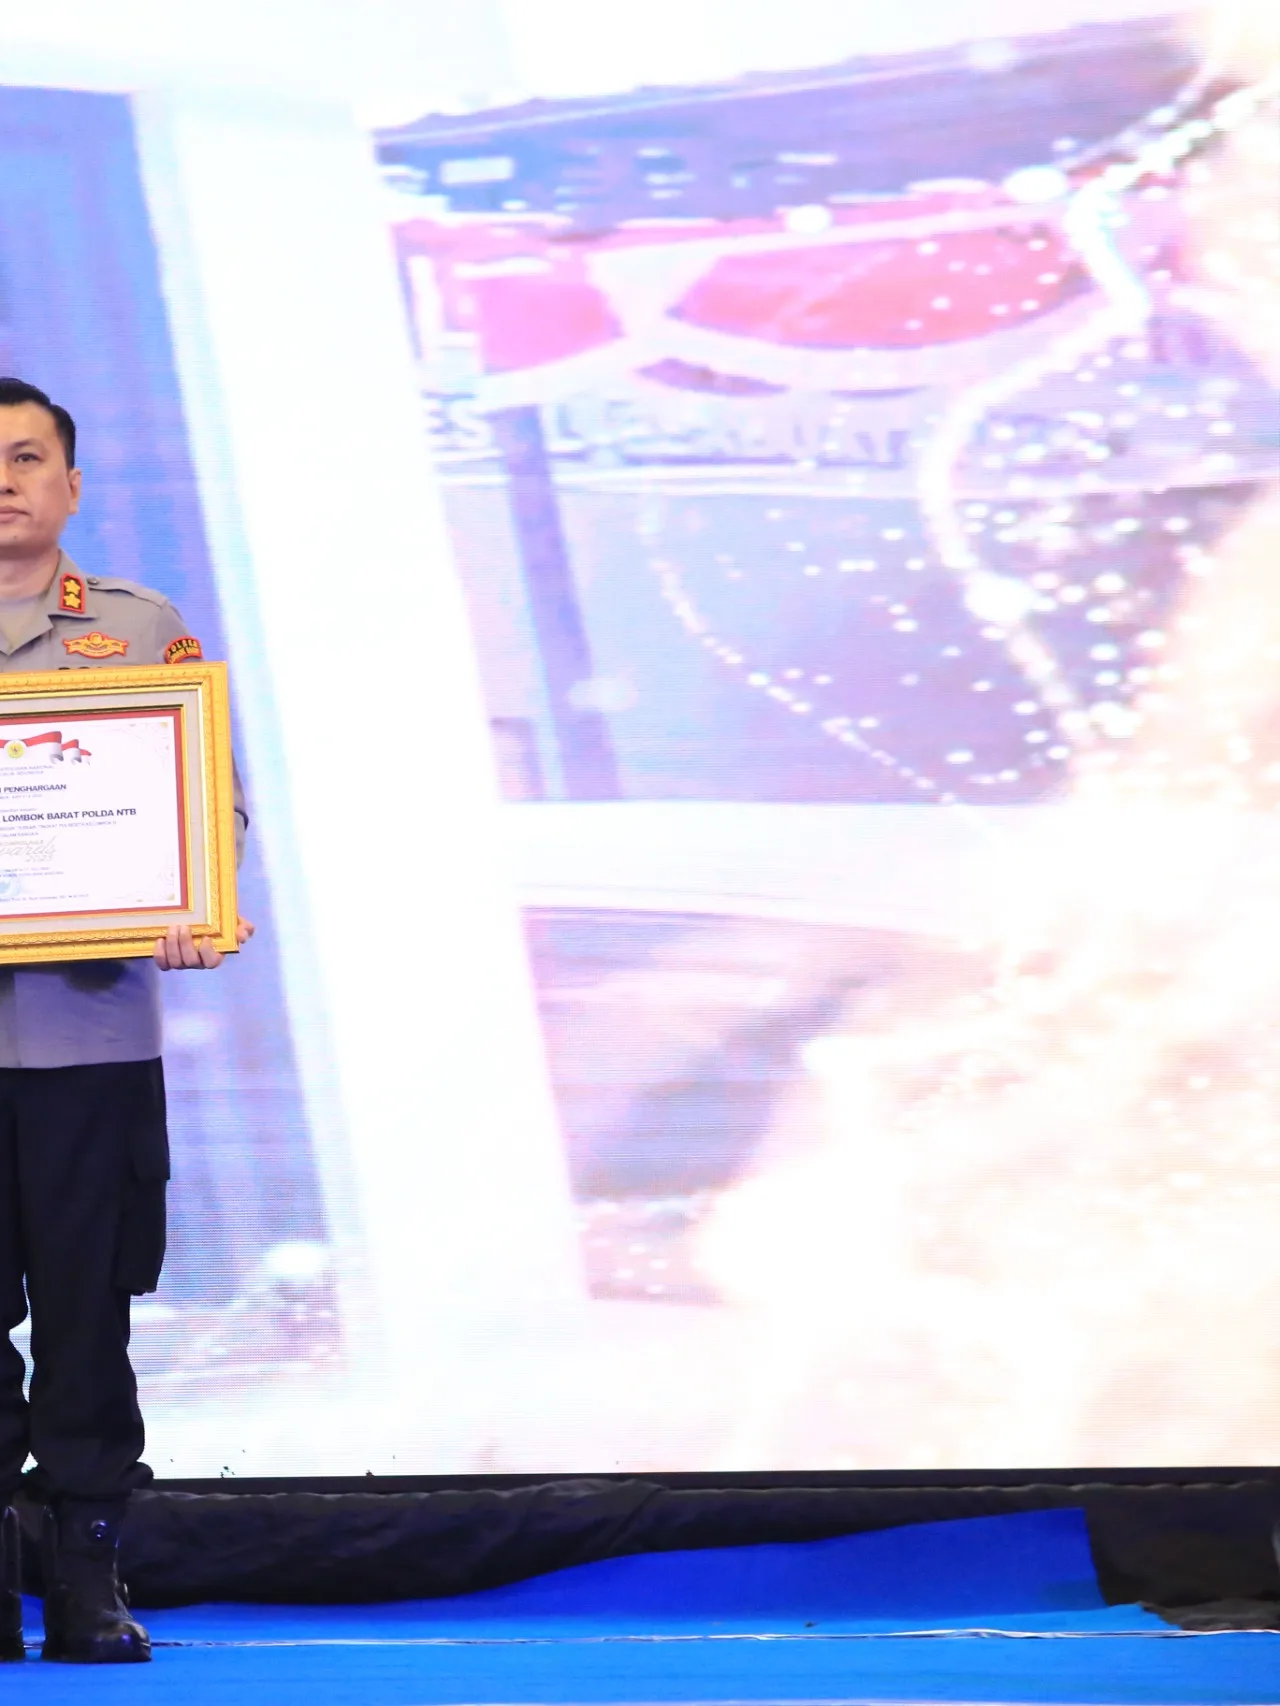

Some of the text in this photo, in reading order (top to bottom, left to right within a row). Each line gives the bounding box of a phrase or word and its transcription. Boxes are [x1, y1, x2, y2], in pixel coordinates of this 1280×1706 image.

[3, 784, 67, 793] PENGHARGAAN
[2, 812, 45, 823] LOMBOK
[47, 811, 79, 820] BARAT
[81, 809, 114, 819] POLDA
[116, 808, 137, 817] NTB
